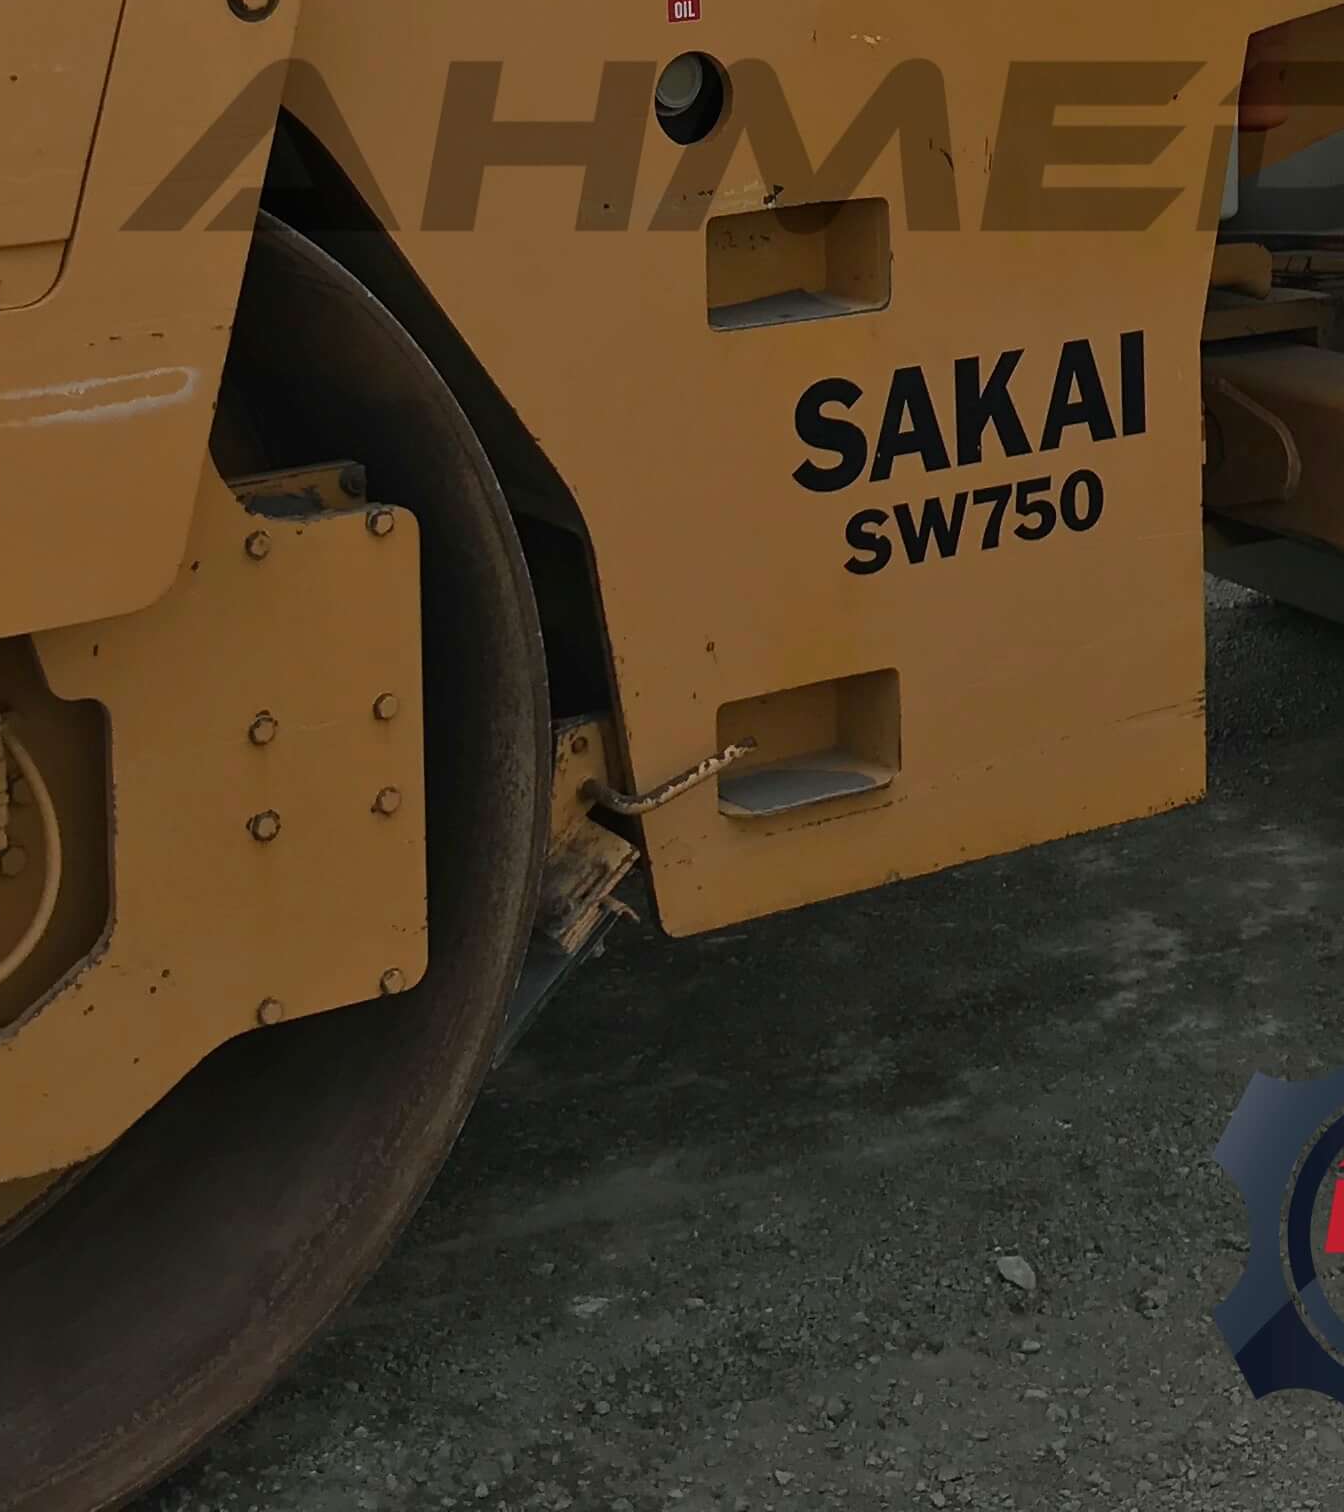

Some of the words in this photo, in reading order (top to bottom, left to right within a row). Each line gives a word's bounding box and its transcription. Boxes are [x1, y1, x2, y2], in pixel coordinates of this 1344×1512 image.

[674, 0, 696, 19] OIL
[792, 330, 1147, 493] SAKAI
[843, 469, 1105, 575] SW750
